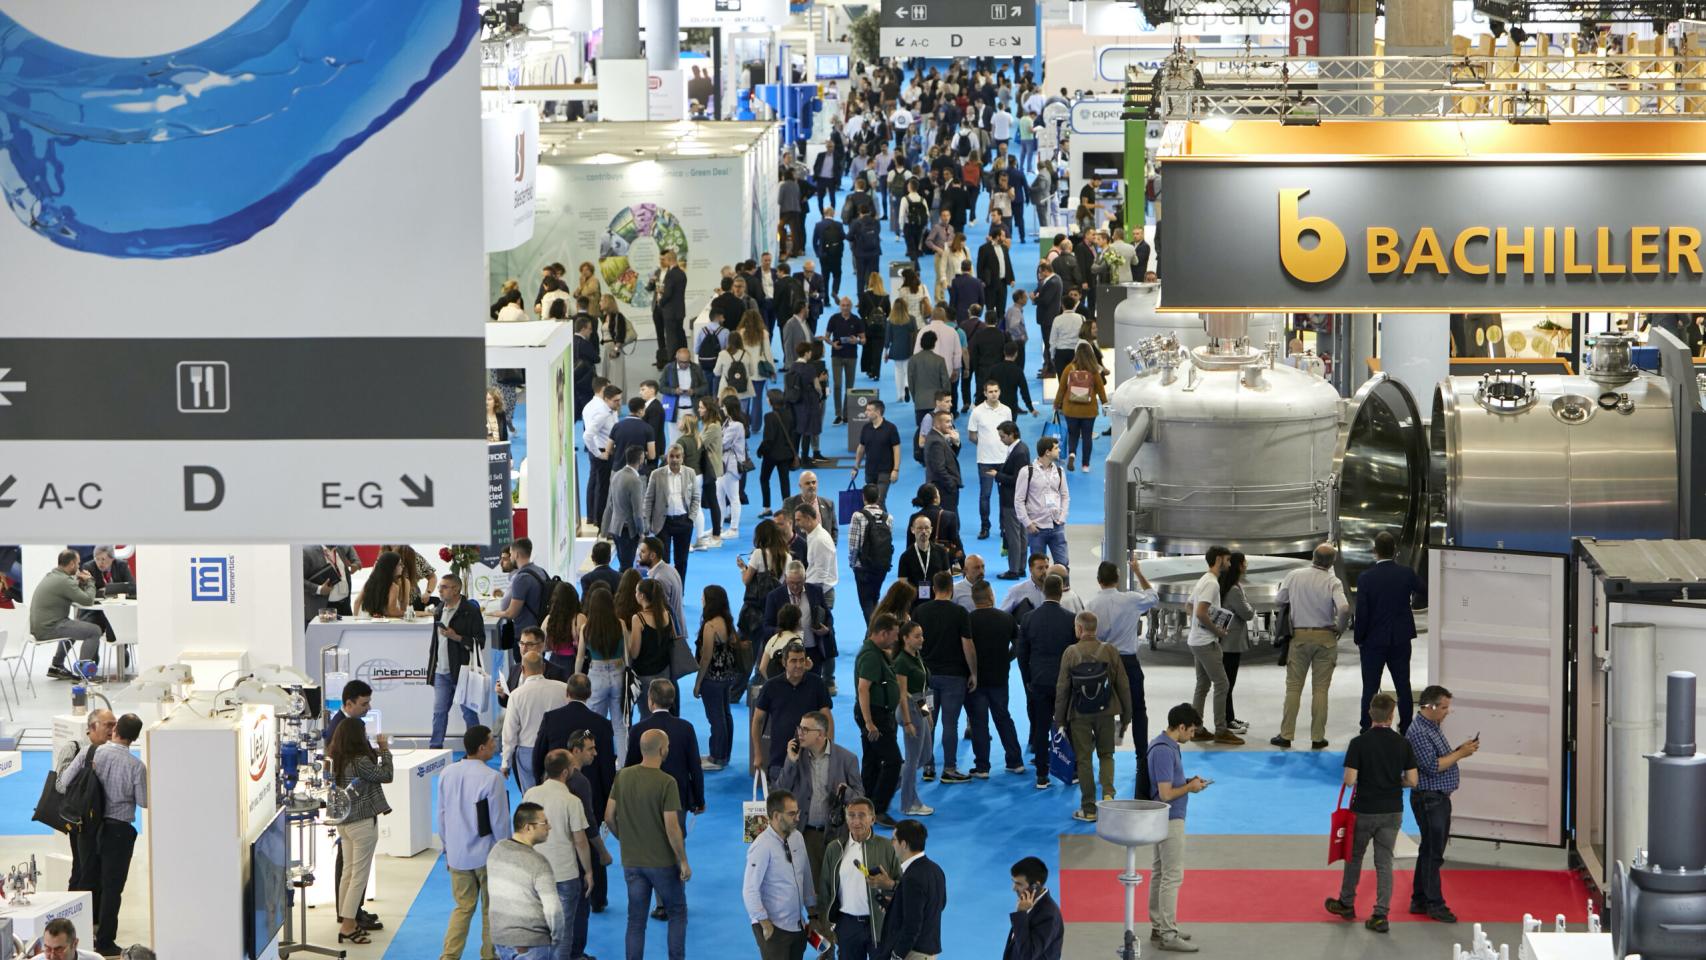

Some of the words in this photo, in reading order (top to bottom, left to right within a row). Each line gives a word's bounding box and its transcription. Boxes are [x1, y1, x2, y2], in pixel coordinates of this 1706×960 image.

[910, 38, 929, 47] A-C
[951, 34, 963, 48] D
[989, 38, 1007, 47] E-G
[1366, 226, 1704, 275] BACHILLER
[38, 483, 103, 510] A-C
[183, 465, 225, 512] D
[321, 482, 384, 510] E-G
